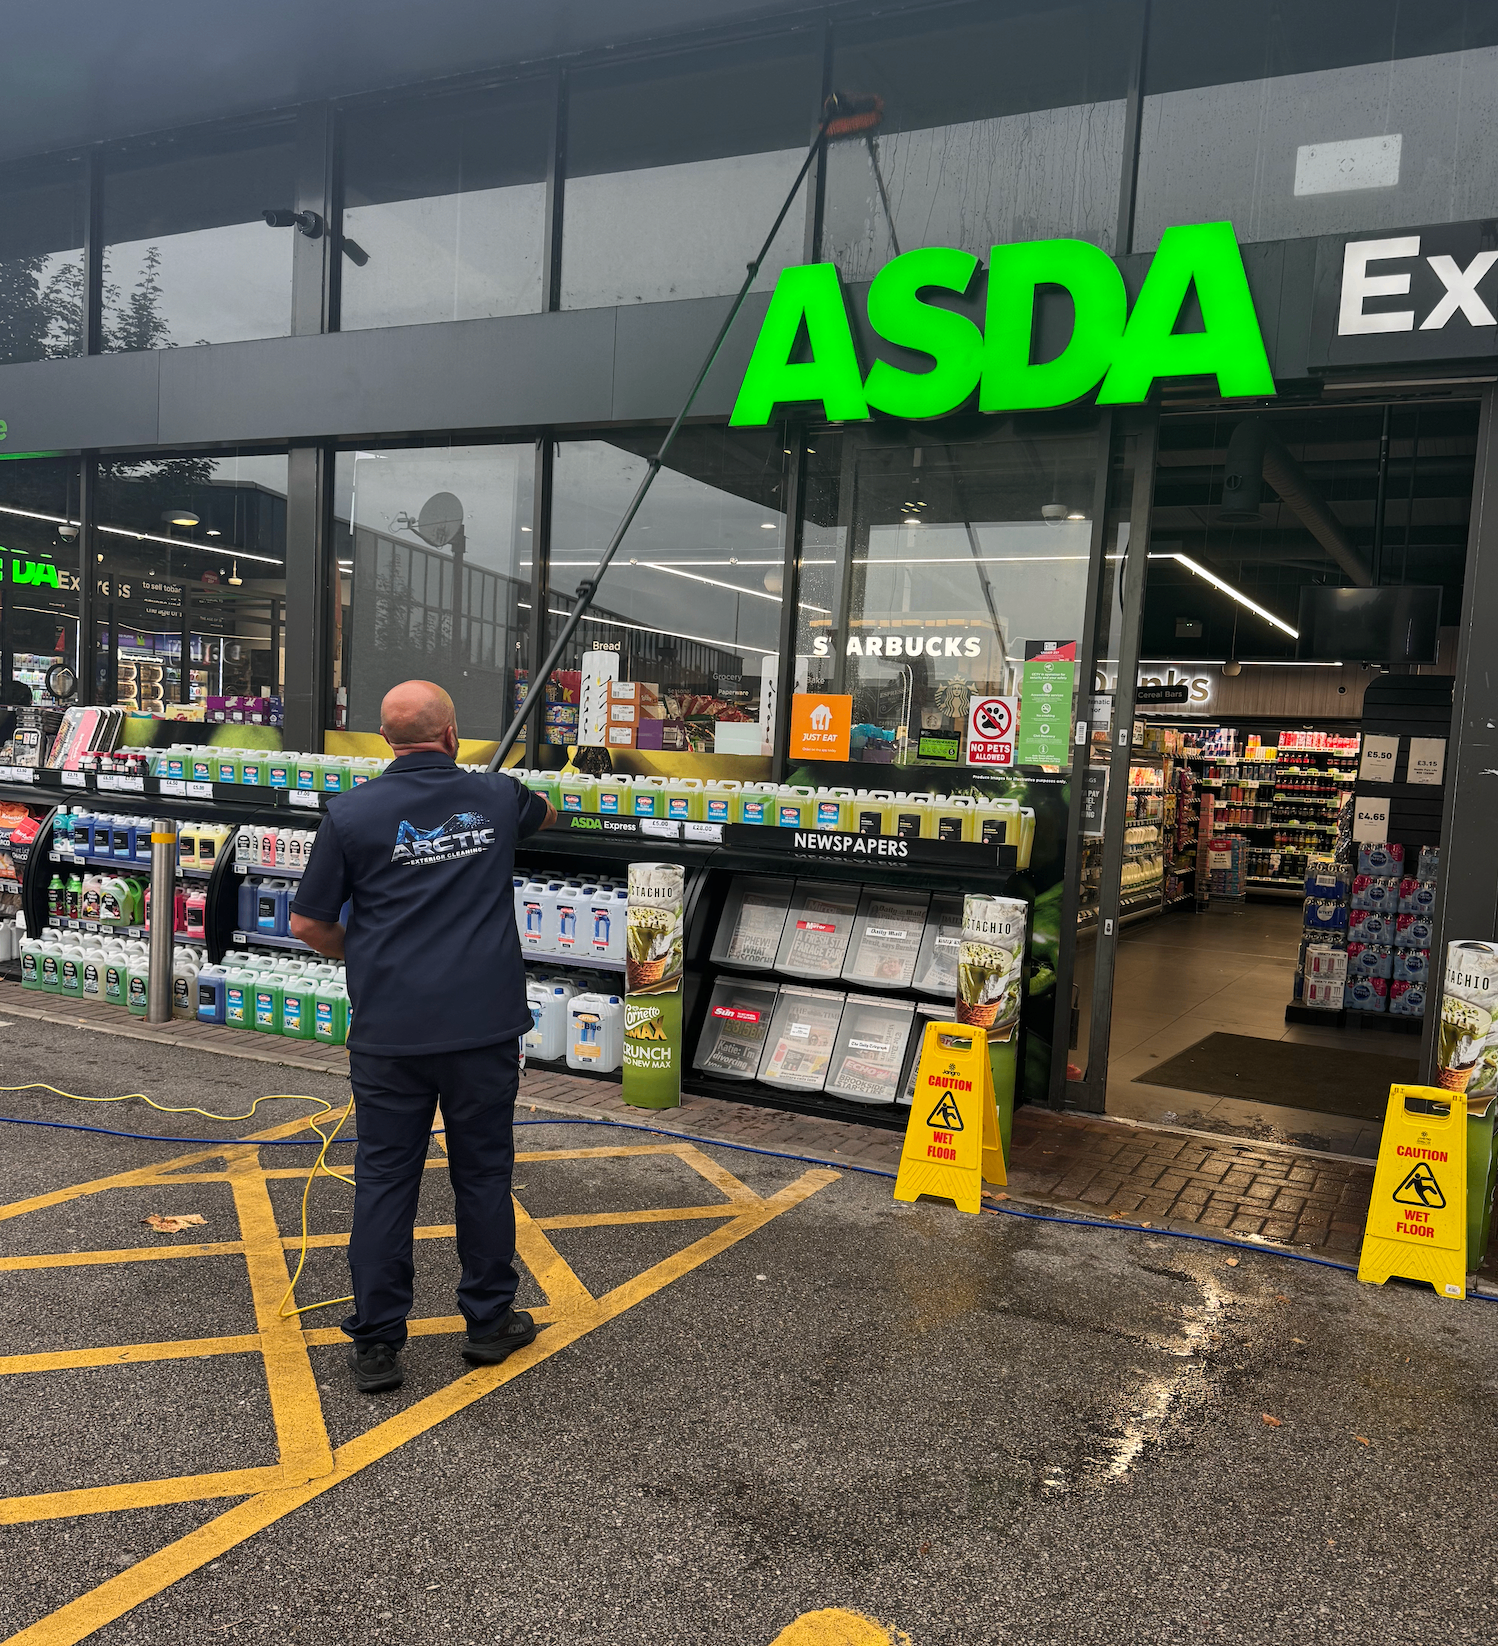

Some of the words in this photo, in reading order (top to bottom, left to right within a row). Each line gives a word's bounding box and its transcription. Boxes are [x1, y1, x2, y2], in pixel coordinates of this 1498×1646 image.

[728, 221, 1277, 427] ASDA
[57, 570, 132, 599] Exres
[593, 640, 620, 652] Bread
[813, 636, 981, 657] SARBUCKS
[712, 672, 742, 682] Grocery
[718, 688, 749, 697] Paperware
[1138, 690, 1163, 699] Cereal
[1164, 690, 1182, 698] Bars
[802, 733, 821, 743] JUST
[822, 734, 838, 742] EAT
[971, 744, 984, 752] NO
[986, 745, 1010, 753] PETS
[1367, 751, 1392, 760] £5.50
[1358, 812, 1385, 820] £4.65
[570, 817, 602, 830] ASDA
[604, 822, 636, 831] Express
[391, 828, 496, 862] ARCTIC
[794, 833, 908, 857] NEWSPAPERS
[410, 855, 445, 865] EXTERIOR
[447, 848, 482, 858] CLEANING
[745, 935, 771, 948] PHEW!
[797, 931, 803, 940] A
[804, 932, 829, 945] FRESH
[743, 944, 765, 956] WHAT
[794, 941, 824, 957] FARAGE
[896, 944, 917, 952] Burnha
[624, 1004, 660, 1030] Cornetto
[714, 1008, 735, 1017] Sun
[625, 1015, 667, 1041] MAX
[623, 1042, 671, 1060] CRUNCH
[718, 1040, 741, 1055] Katie:
[744, 1047, 755, 1059] I'm
[632, 1060, 650, 1068] NEW
[713, 1052, 748, 1070] divorcing
[845, 1060, 877, 1075] ECHO
[839, 1075, 885, 1091] BROOKSIDE
[928, 1075, 972, 1092] CAUTION
[934, 1131, 954, 1145] WET
[927, 1146, 956, 1161] FLOOR
[1396, 1145, 1448, 1162] CAUTION
[1404, 1210, 1430, 1223] WET
[1396, 1222, 1434, 1238] FLOOR
